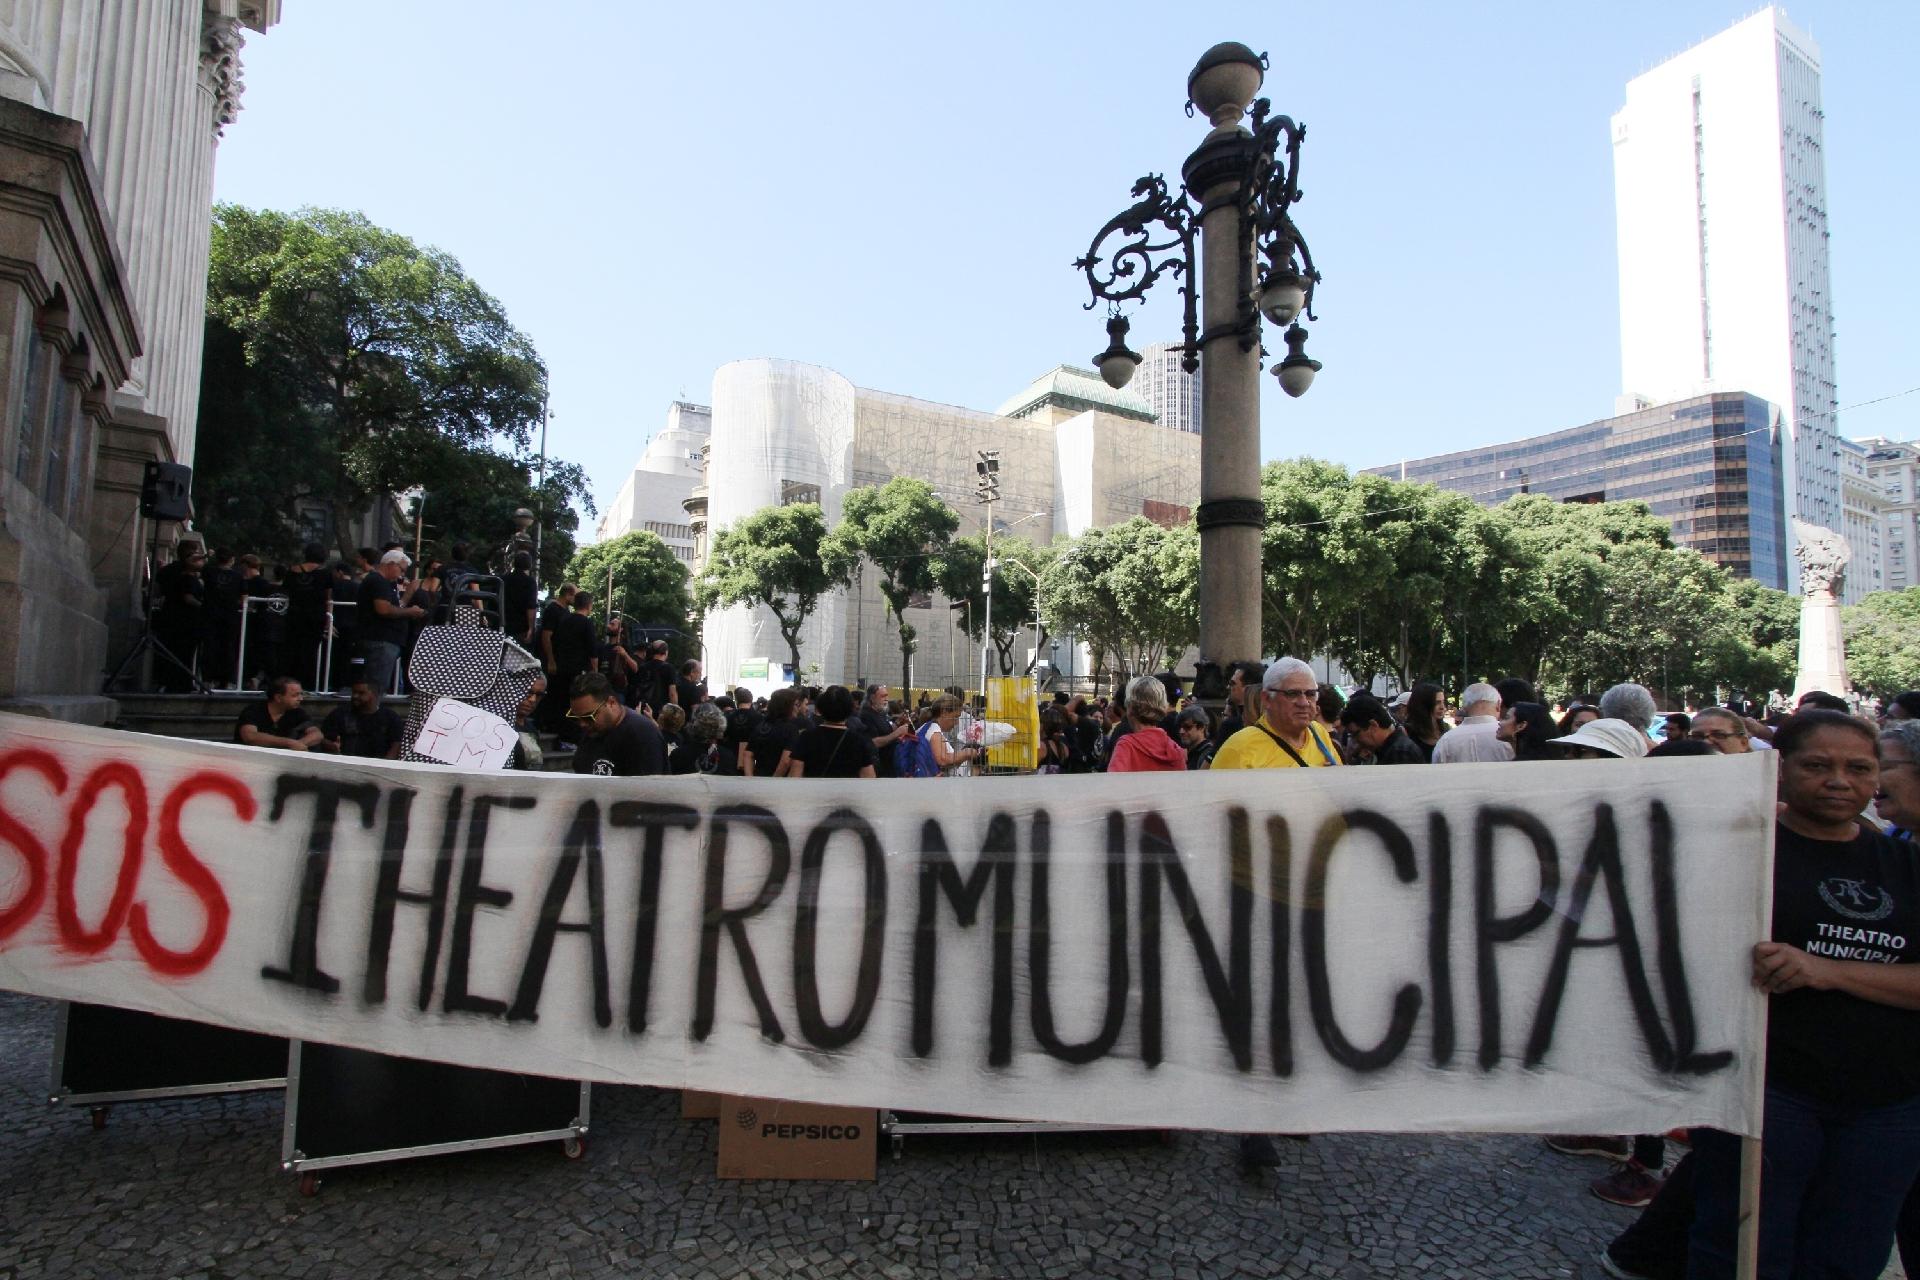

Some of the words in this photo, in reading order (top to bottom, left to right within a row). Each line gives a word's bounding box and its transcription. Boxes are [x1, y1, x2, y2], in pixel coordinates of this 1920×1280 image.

[435, 703, 508, 751] SOS
[0, 747, 258, 978] SOS
[261, 773, 888, 1050] THEATRO
[910, 799, 1734, 1078] MUNICIPAL
[1817, 923, 1906, 949] THEATRO
[761, 1123, 861, 1140] PEPSICO
